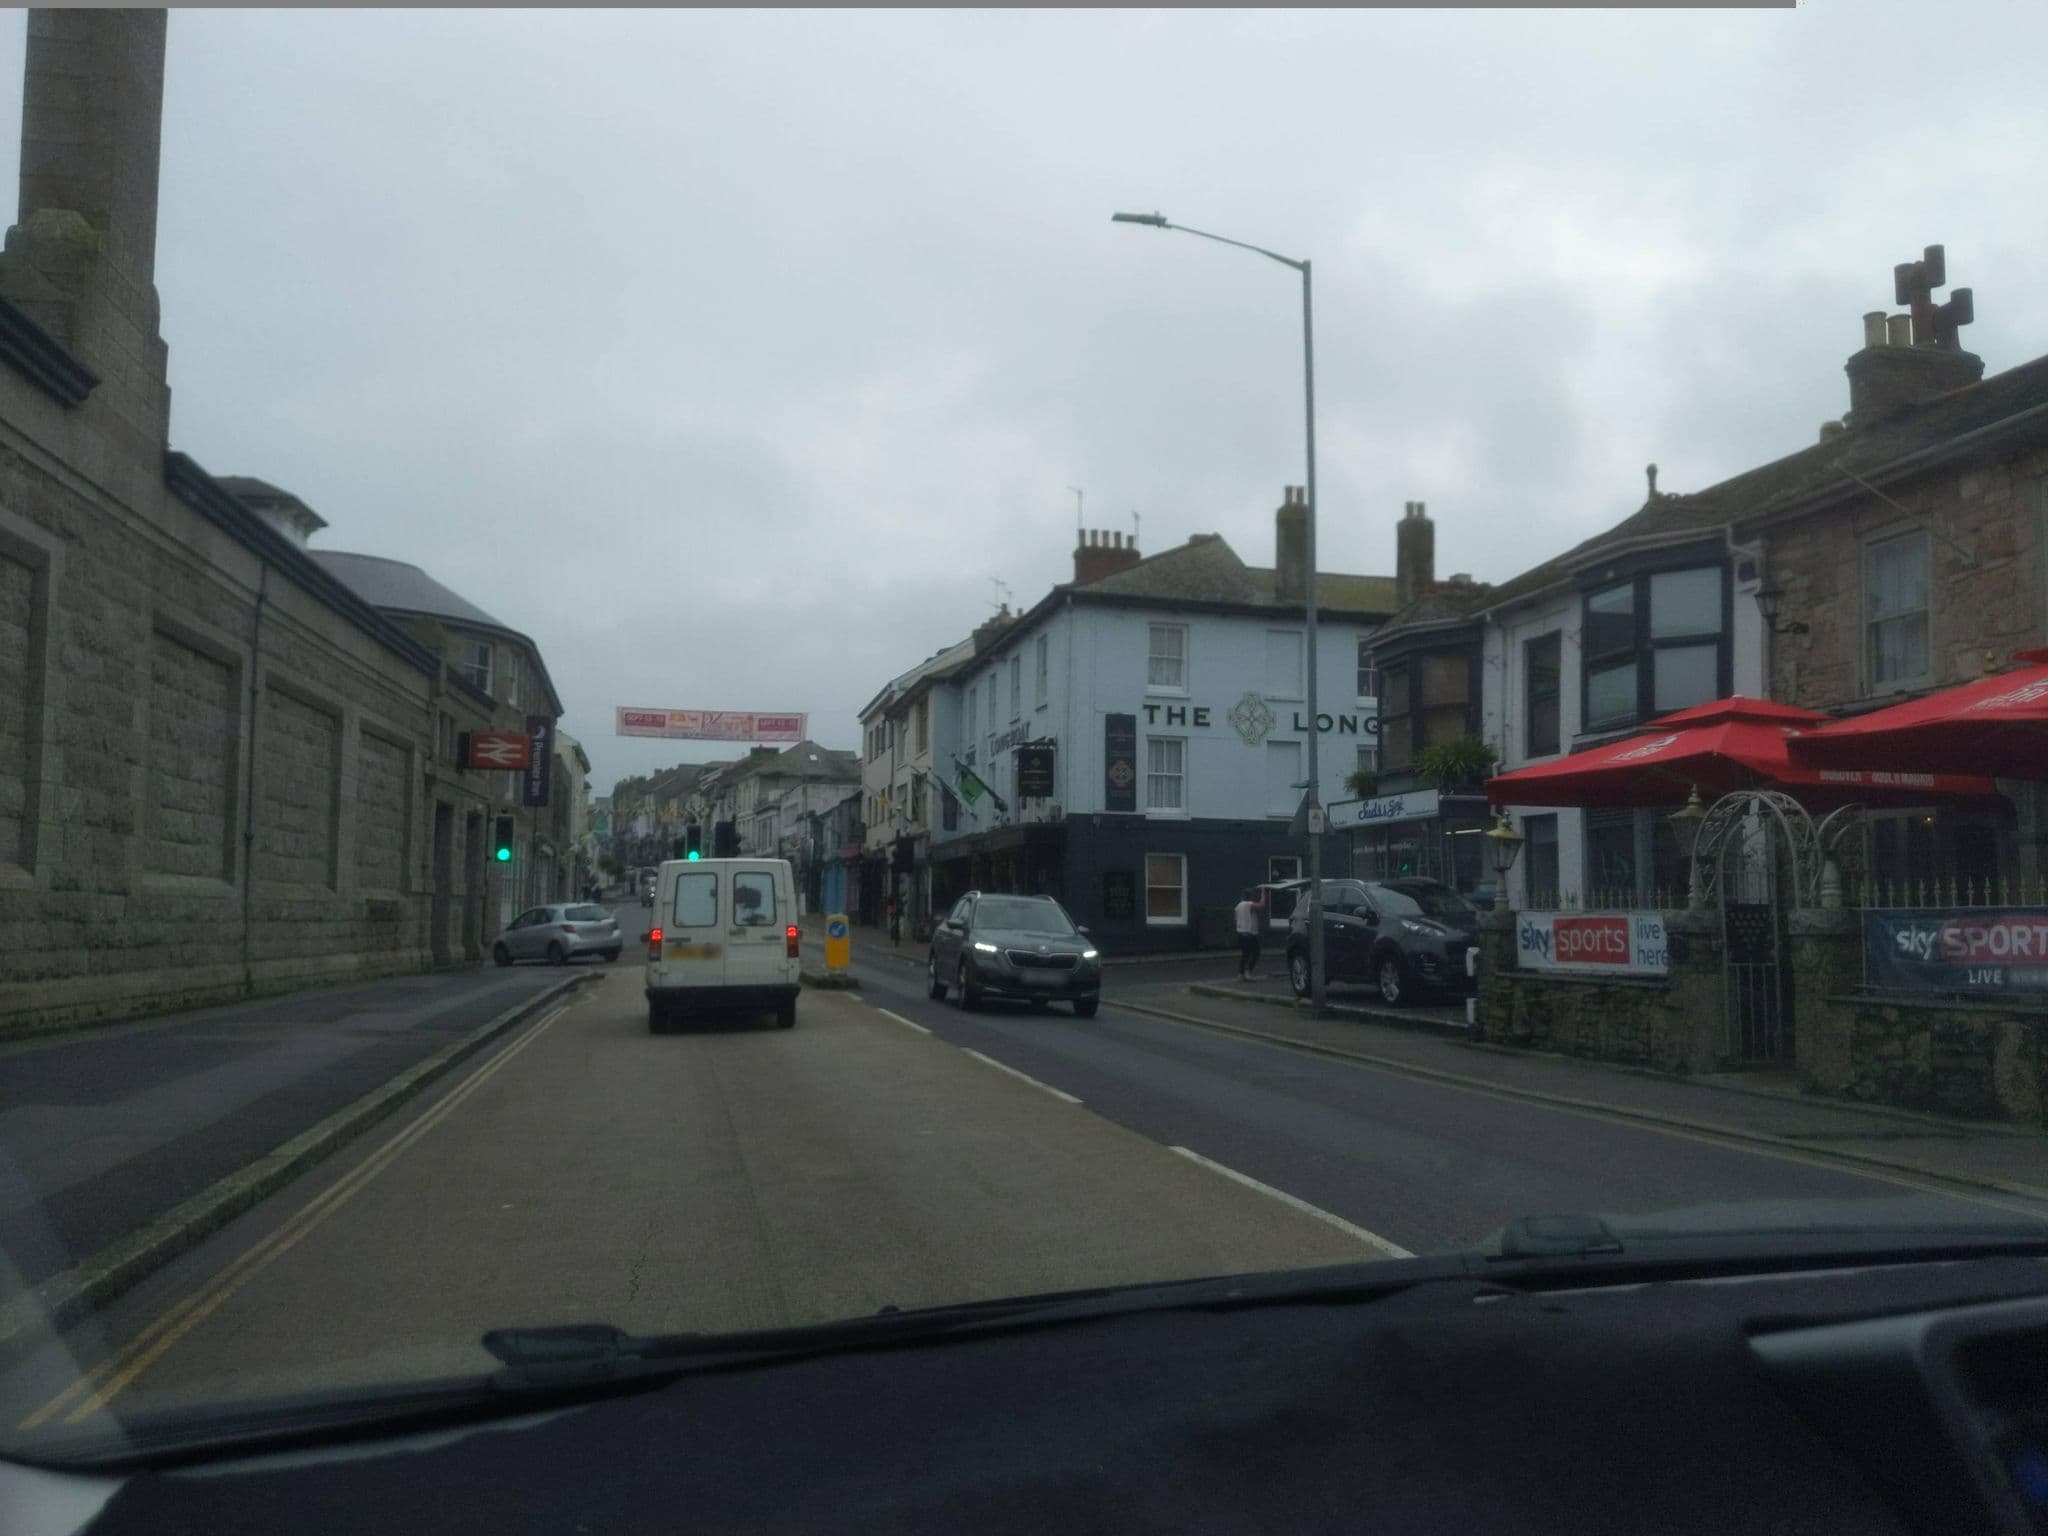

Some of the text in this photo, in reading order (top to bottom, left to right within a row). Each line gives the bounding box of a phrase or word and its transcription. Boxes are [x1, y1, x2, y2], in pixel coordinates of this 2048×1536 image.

[1142, 703, 1379, 736] THE LONG
[532, 741, 544, 797] Premier Inn
[1520, 919, 1625, 958] sky sports
[1636, 917, 1661, 939] live
[1896, 923, 2048, 961] sky SPORT
[1636, 944, 1669, 965] here
[1968, 968, 2003, 985] LIVE
